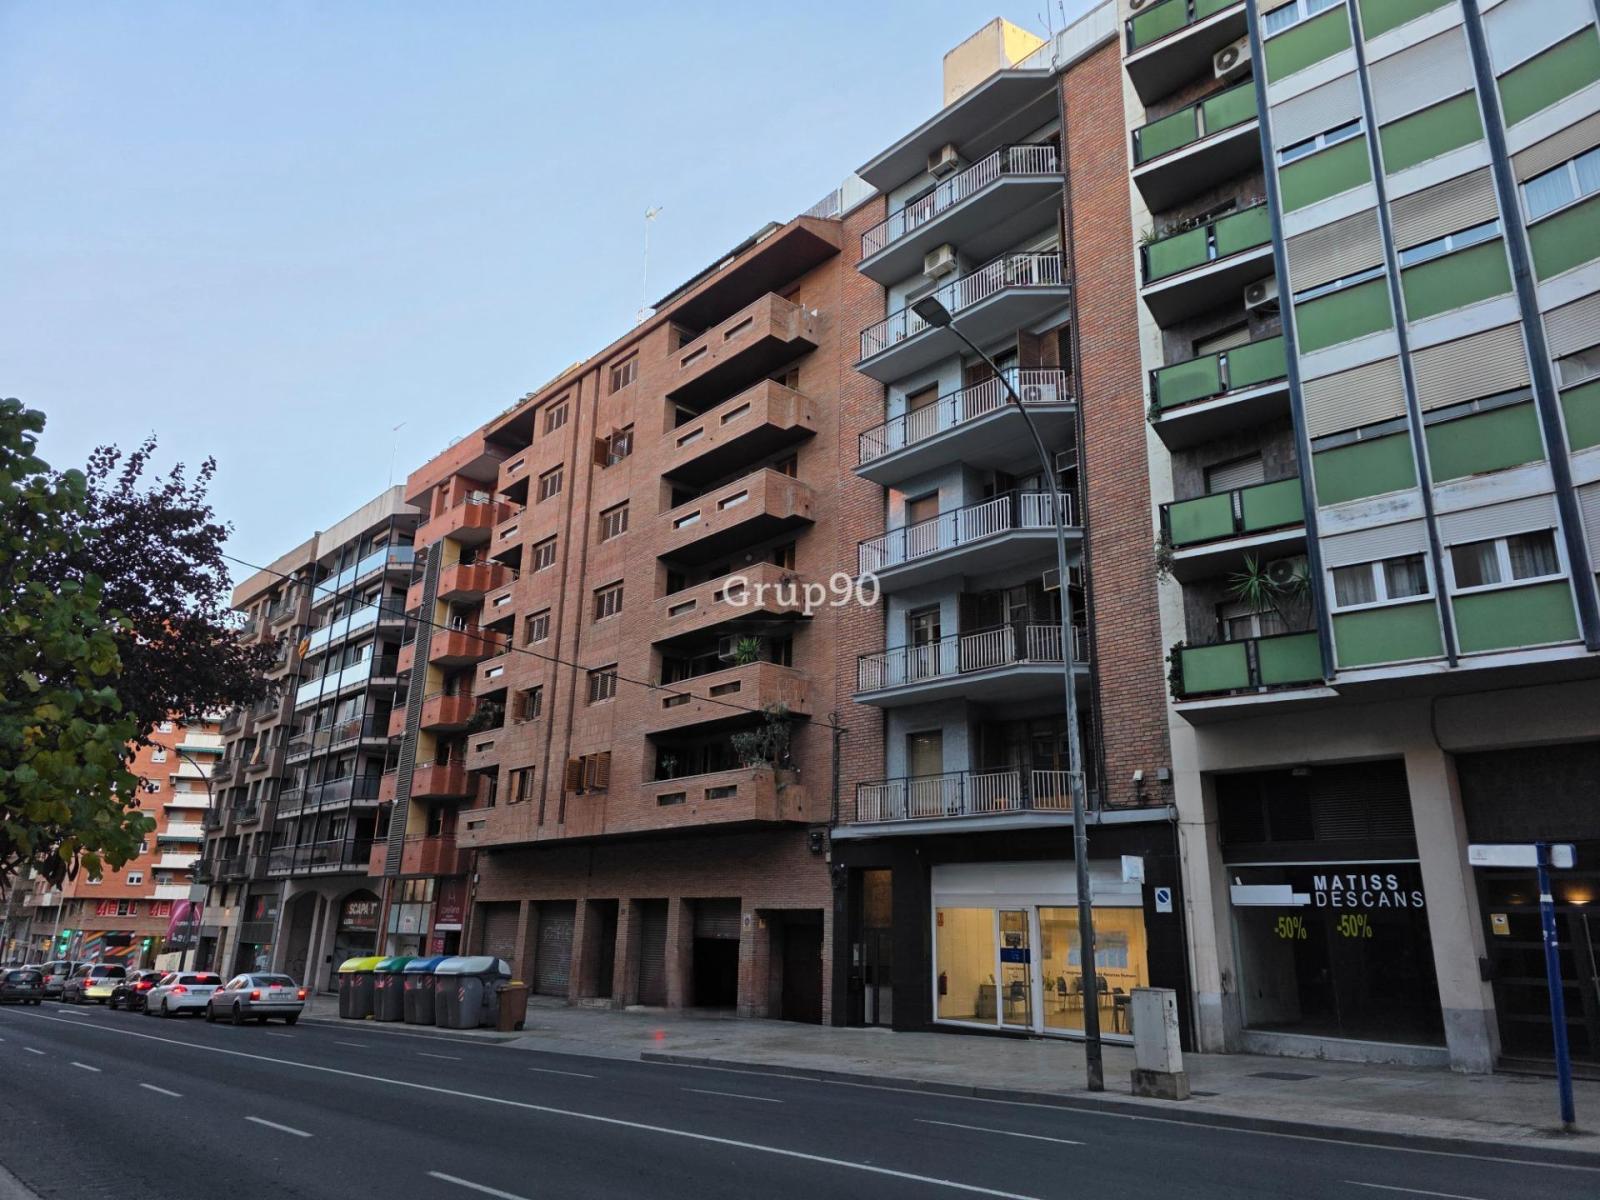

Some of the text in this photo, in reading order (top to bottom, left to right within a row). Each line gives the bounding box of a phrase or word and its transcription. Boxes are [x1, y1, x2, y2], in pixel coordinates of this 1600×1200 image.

[1313, 874, 1399, 891] MATISS
[1315, 891, 1425, 908] DESCANS
[1274, 916, 1307, 940] -50%
[1337, 914, 1373, 938] -50%
